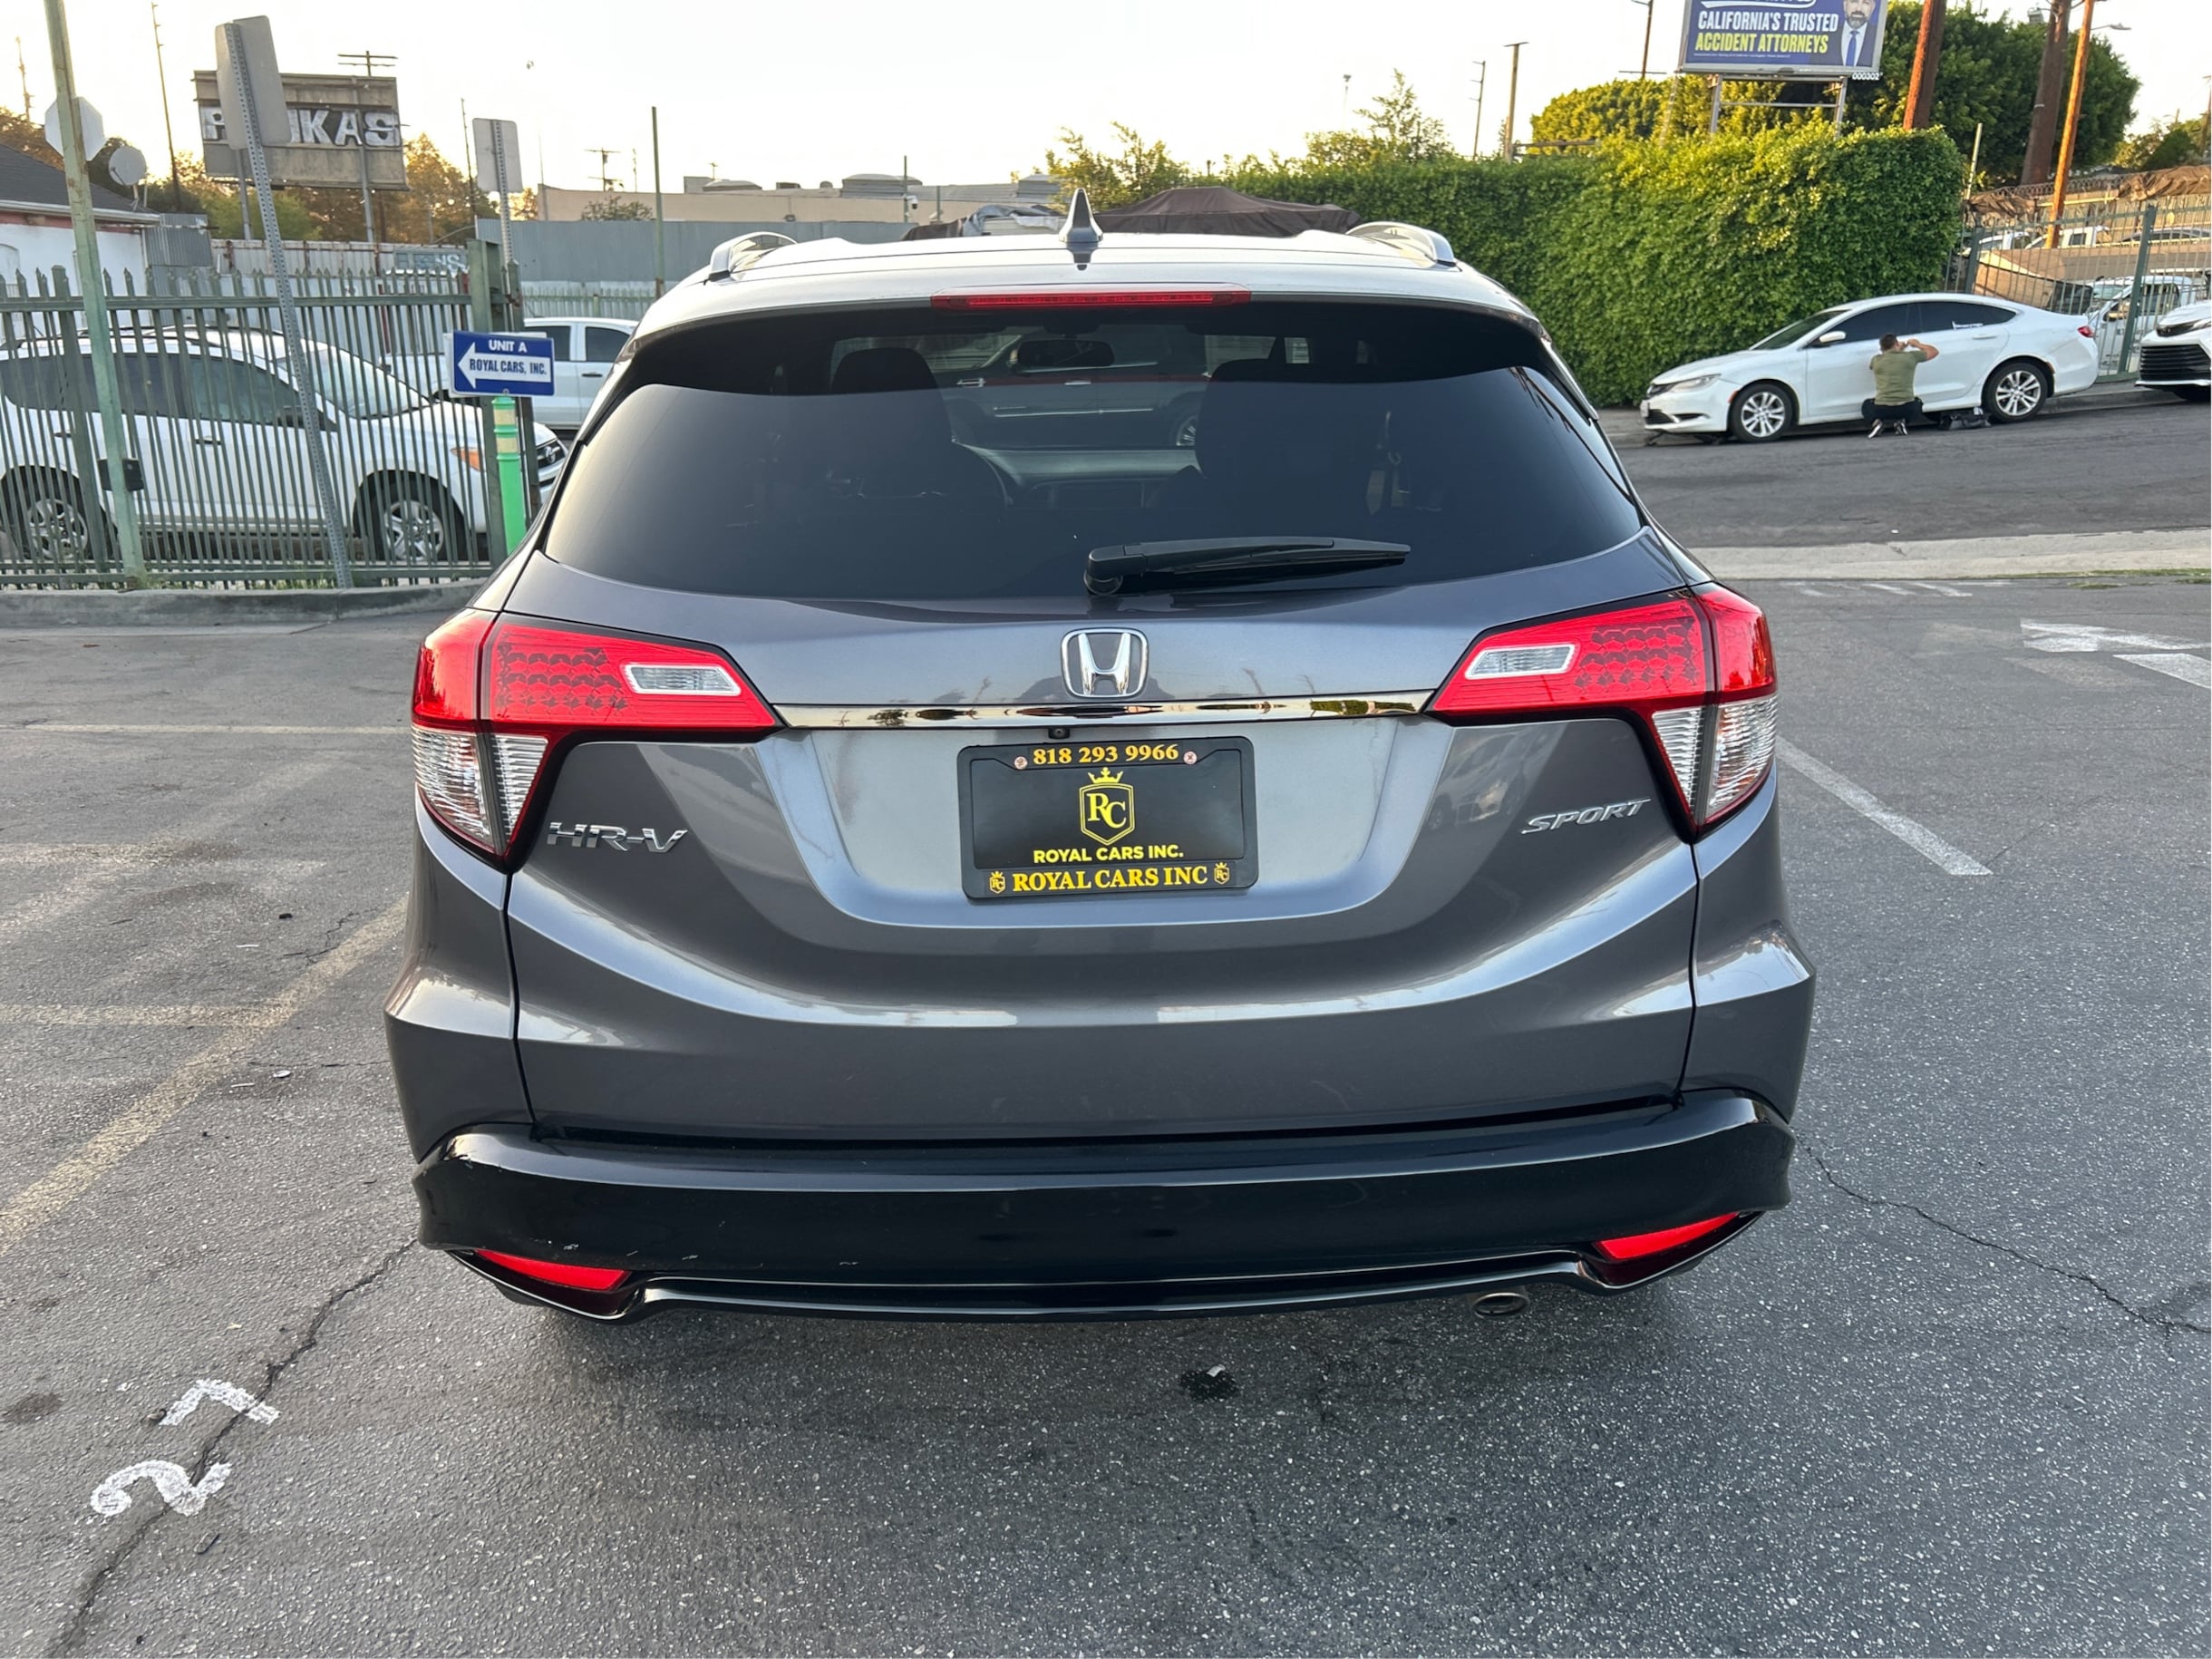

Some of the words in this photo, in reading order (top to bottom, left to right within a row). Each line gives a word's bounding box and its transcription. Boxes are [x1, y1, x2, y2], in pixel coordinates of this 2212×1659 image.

[1698, 10, 1780, 31] CALIFORNIA'S
[1783, 13, 1838, 33] TRUSTED
[1695, 32, 1757, 52] ACCIDENT
[1757, 34, 1829, 53] ATTORNEYS
[488, 339, 515, 352] UNIT
[519, 342, 528, 353] A
[470, 358, 499, 372] ROYAL
[500, 360, 527, 375] CARS,
[529, 363, 548, 375] INC.
[1033, 748, 1072, 765] 818
[1078, 745, 1118, 763] 293
[1125, 743, 1179, 762] 9966
[1087, 792, 1127, 829] RC
[1521, 797, 1652, 835] SPORT
[547, 821, 688, 853] HR-V
[1033, 848, 1092, 864] ROYAL
[1096, 845, 1144, 861] CARS
[1148, 844, 1184, 859] INC.
[1012, 871, 1091, 892] ROYAL
[1094, 868, 1159, 889] CARS
[1164, 866, 1208, 886] INC
[91, 1378, 282, 1517] 27
